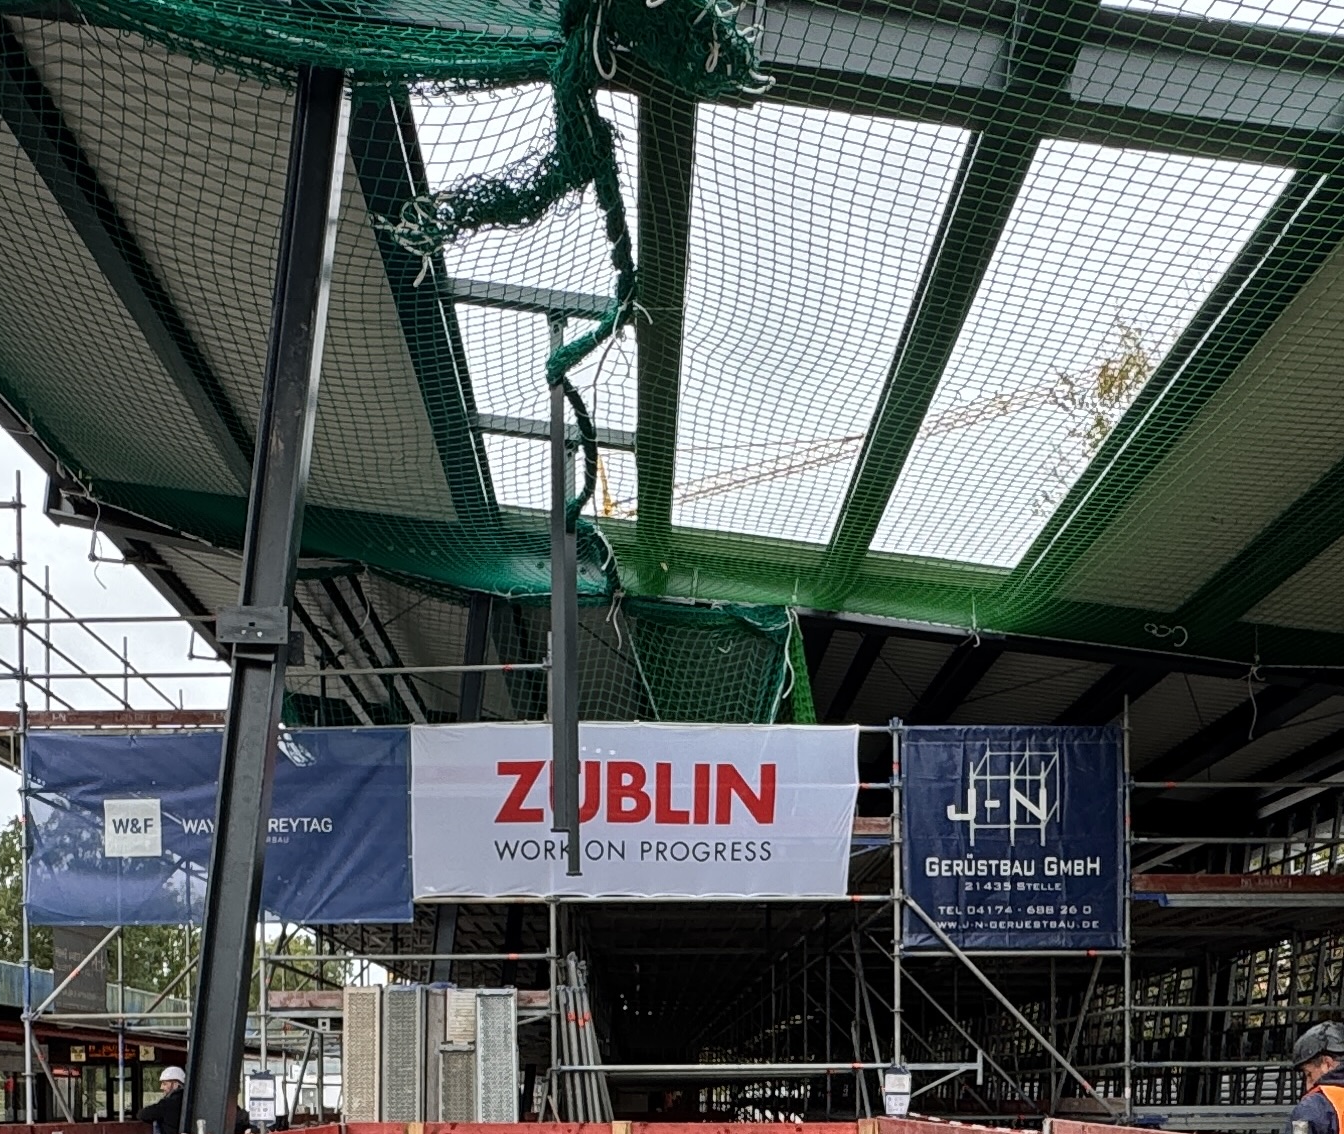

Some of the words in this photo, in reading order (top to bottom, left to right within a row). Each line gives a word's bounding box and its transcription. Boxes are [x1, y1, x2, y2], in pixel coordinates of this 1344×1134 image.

[113, 818, 154, 834] W&F
[267, 817, 333, 833] REYTAG
[494, 840, 569, 861] WORK
[585, 840, 625, 861] ON
[640, 840, 773, 862] PROGRESS
[925, 853, 1035, 877] GERÜSTBAU
[964, 882, 1012, 891] 21435
[938, 905, 962, 915] TEL
[967, 905, 1012, 915] 04174
[1026, 905, 1054, 915] 688
[1059, 905, 1077, 915] 26
[1083, 905, 1092, 915] 0
